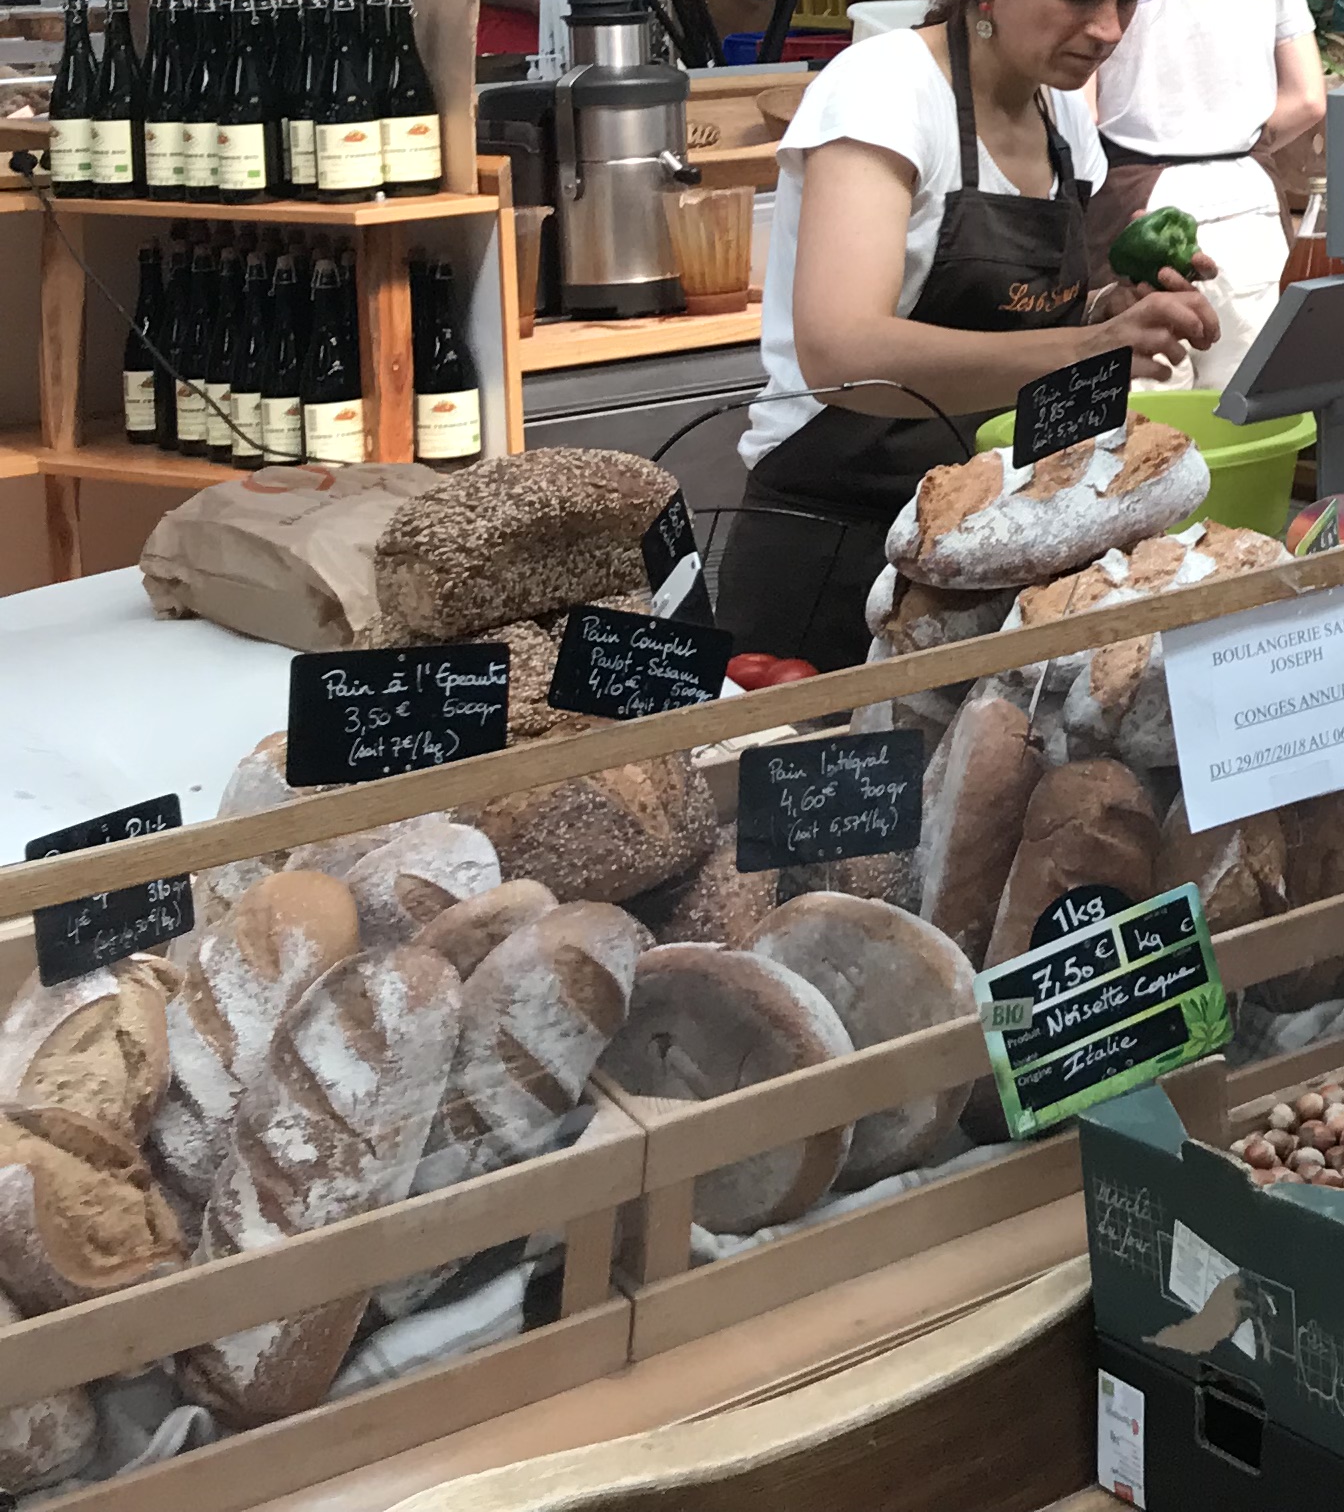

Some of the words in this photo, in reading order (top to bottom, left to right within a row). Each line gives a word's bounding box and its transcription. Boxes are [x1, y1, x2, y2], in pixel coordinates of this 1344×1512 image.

[582, 615, 621, 644] Pain
[631, 627, 698, 660] Complet
[1212, 625, 1322, 667] BOULANGERIE
[590, 646, 633, 671] Pavot
[1269, 646, 1324, 674] JOSEPH
[320, 669, 375, 699] Pain
[344, 700, 411, 736] 3,50€
[1234, 696, 1297, 728] CONGES
[768, 757, 807, 784] Pain
[820, 744, 890, 780] Intégral
[1209, 759, 1232, 780] DU
[1236, 738, 1307, 770] 29/07/2018
[1308, 730, 1331, 751] AU
[779, 780, 839, 818] 4,60€
[1052, 896, 1106, 933] 1kg
[1134, 928, 1165, 956] kg
[991, 1003, 1024, 1027] BIO
[1045, 985, 1130, 1037] Noisette
[1133, 964, 1201, 998] Coque
[1017, 1065, 1052, 1087] Origine
[1062, 1036, 1138, 1082] Italie
